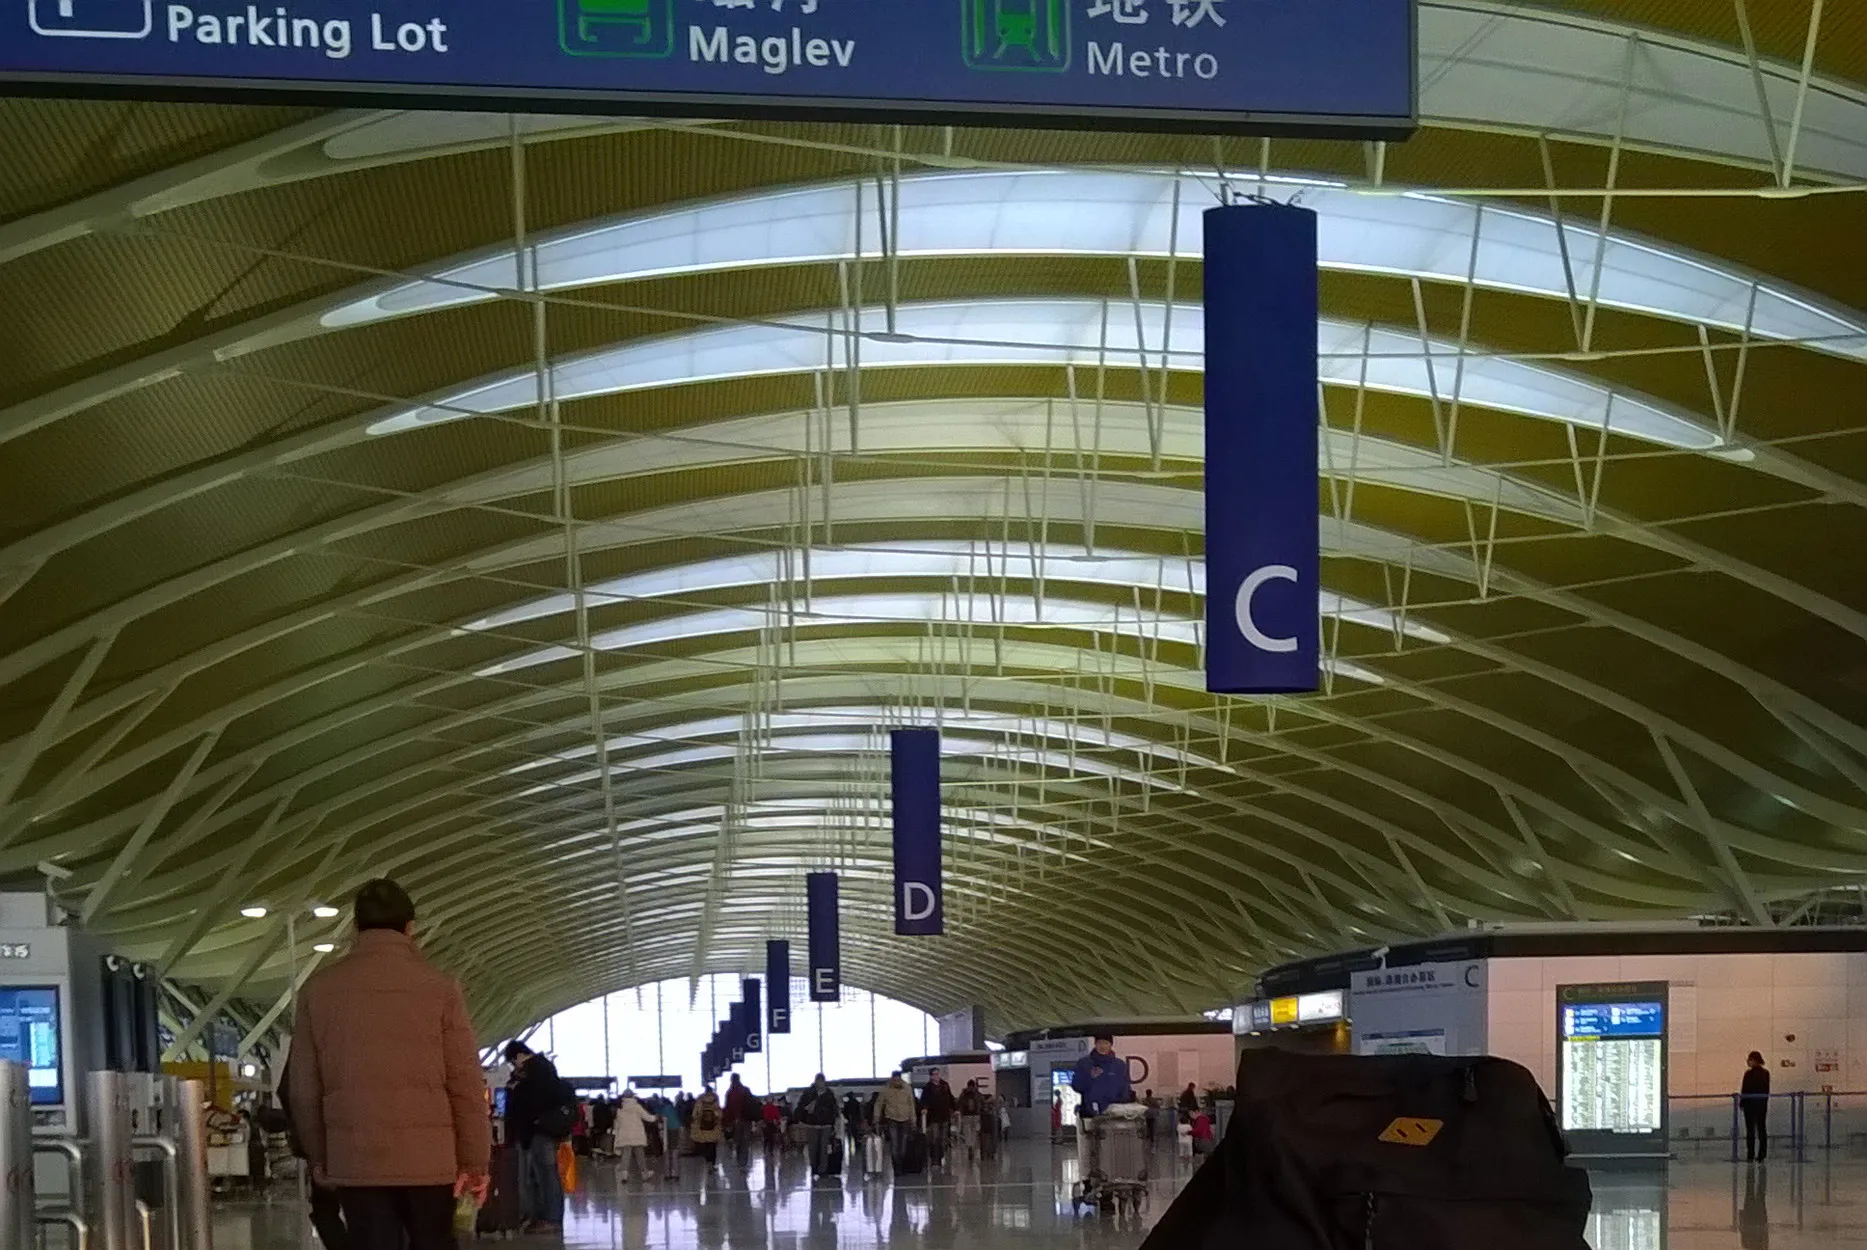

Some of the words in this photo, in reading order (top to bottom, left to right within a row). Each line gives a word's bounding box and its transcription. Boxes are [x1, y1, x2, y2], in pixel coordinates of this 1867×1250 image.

[167, 5, 351, 58] Parking
[371, 14, 448, 53] Lot
[688, 26, 856, 75] Maglev
[1087, 41, 1219, 80] Metro
[1234, 563, 1299, 653] C
[903, 881, 936, 921] D
[815, 968, 835, 994] E
[1464, 964, 1480, 988] C
[773, 1008, 786, 1028] F
[732, 1046, 744, 1060] H
[746, 1033, 760, 1049] G
[1126, 1056, 1149, 1084] D
